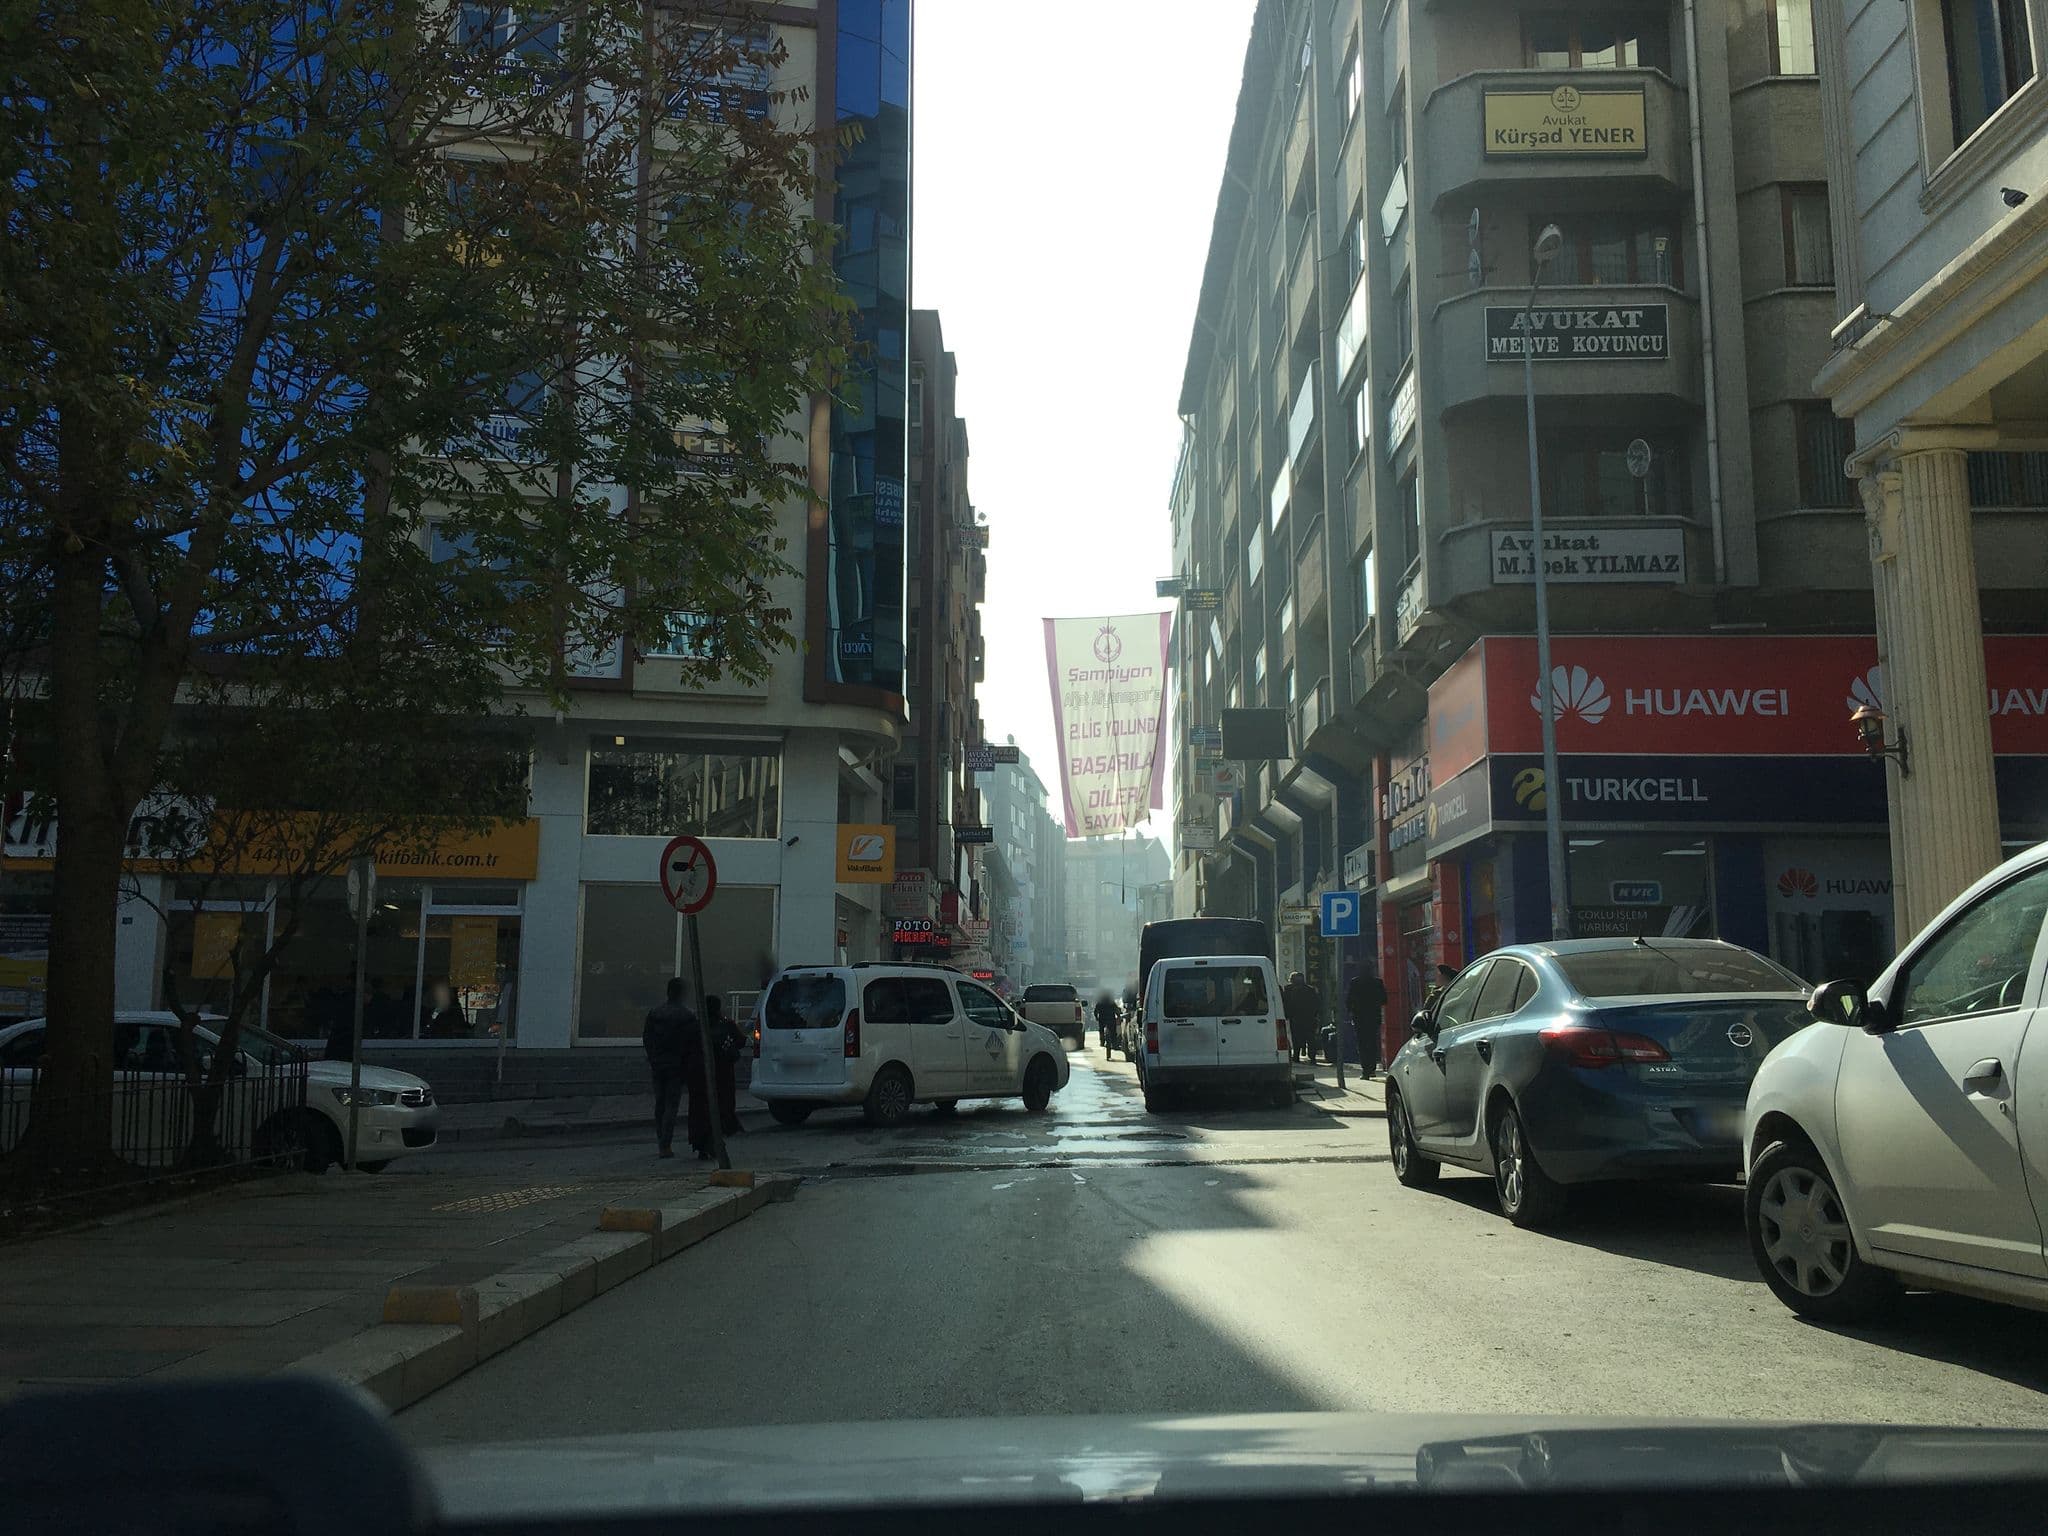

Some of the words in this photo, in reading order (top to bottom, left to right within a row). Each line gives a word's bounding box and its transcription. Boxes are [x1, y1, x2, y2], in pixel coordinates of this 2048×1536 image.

[1542, 115, 1587, 126] Avukat
[1495, 128, 1562, 147] Kürşad
[1569, 128, 1635, 143] YENER
[1510, 311, 1643, 330] AVUKAT
[1572, 335, 1663, 352] KOYUNCU
[1582, 555, 1680, 574] YILMAZ
[1068, 665, 1152, 686] Şampiyon
[1625, 688, 1789, 715] HUAWEI
[1566, 778, 1708, 801] TURKCELL
[1331, 898, 1352, 930] P
[894, 920, 931, 931] FOTO
[892, 929, 933, 944] FİKRET
